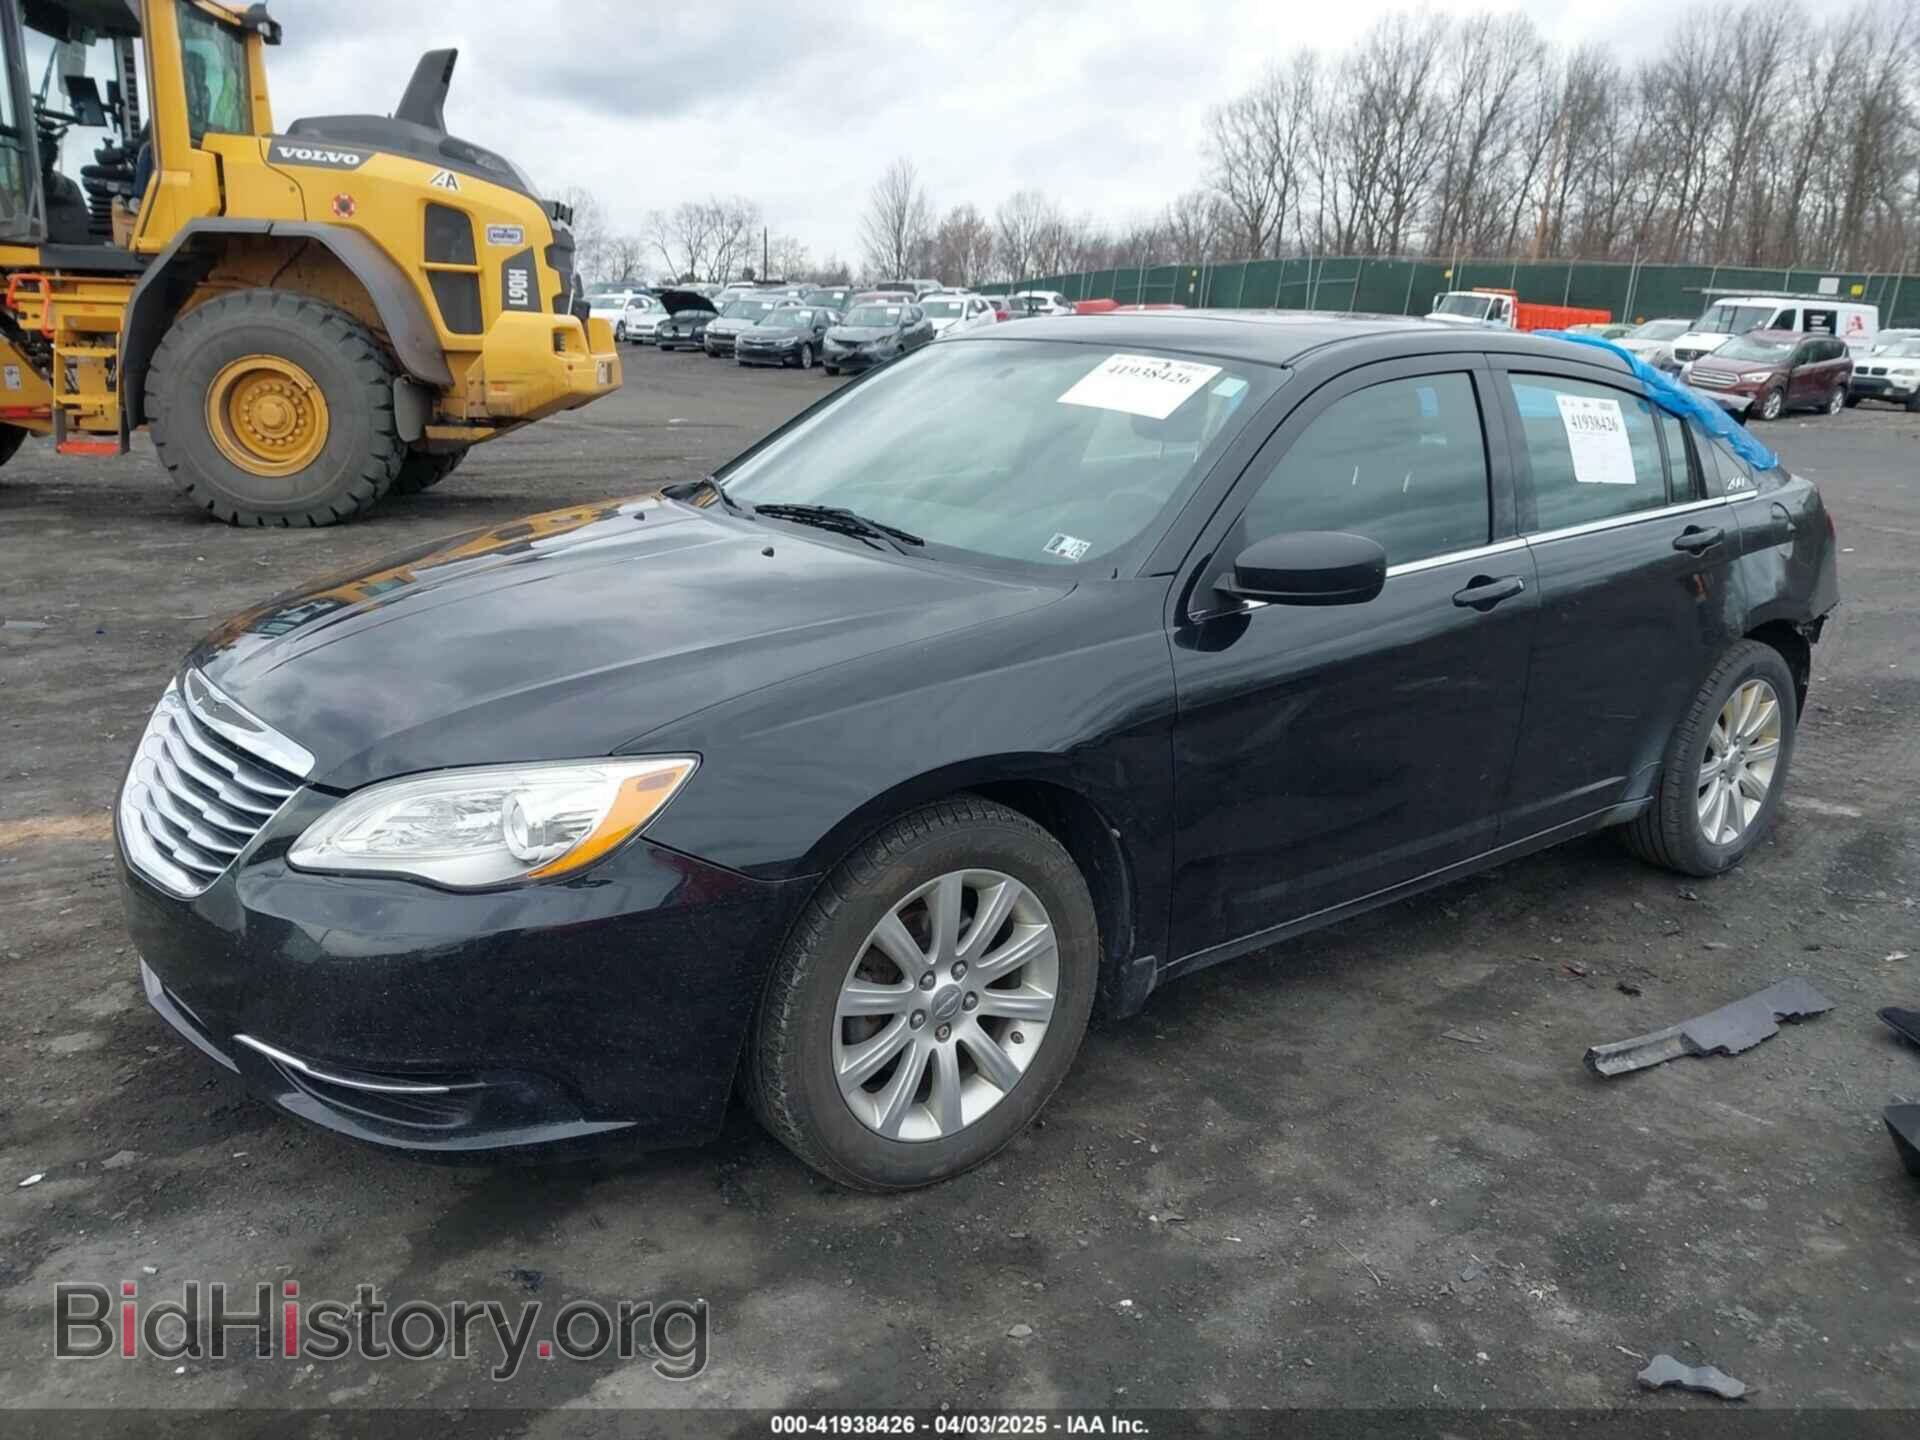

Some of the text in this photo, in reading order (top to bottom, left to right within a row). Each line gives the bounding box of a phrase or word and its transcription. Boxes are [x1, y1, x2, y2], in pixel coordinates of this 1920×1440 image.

[277, 146, 361, 166] VOLVO
[508, 269, 528, 305] L90H
[1571, 413, 1619, 431] 41938426
